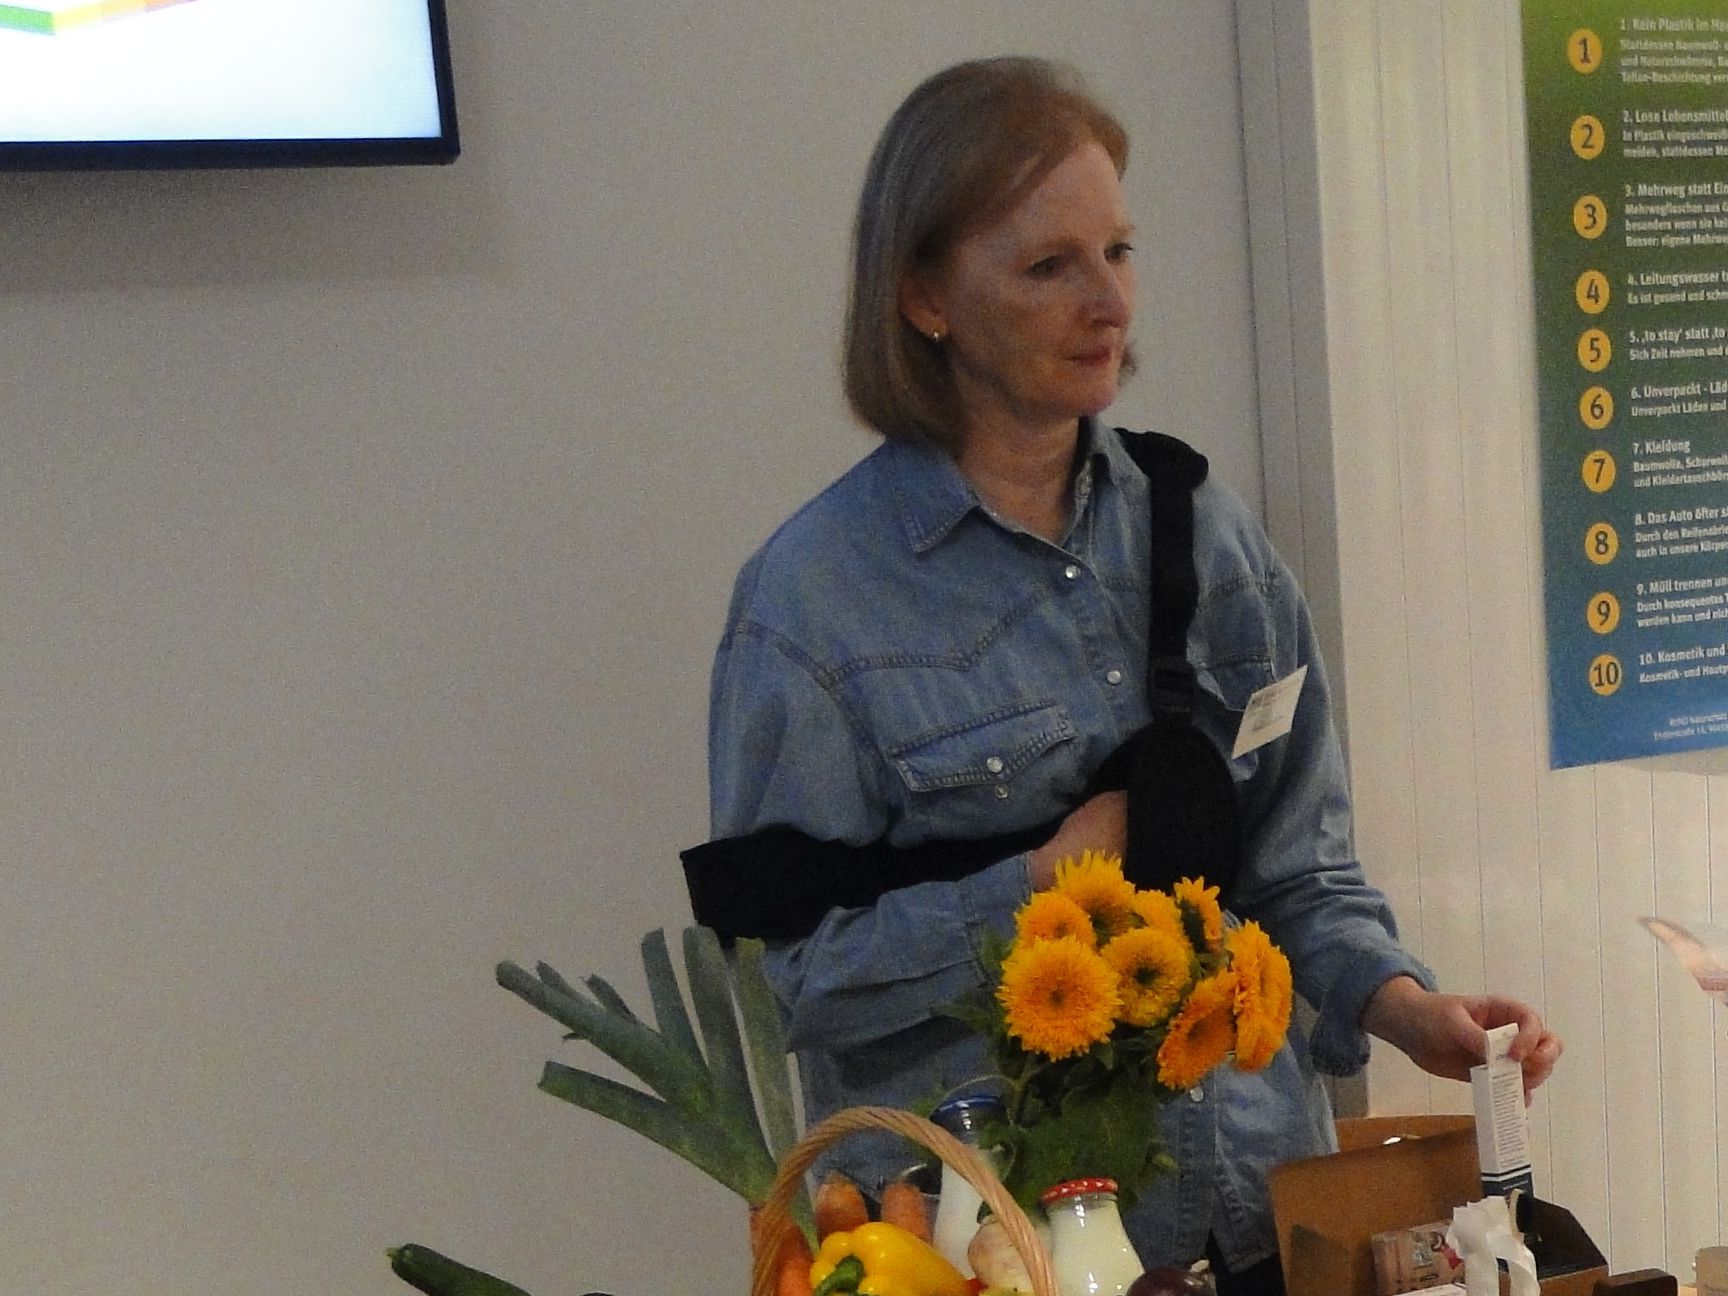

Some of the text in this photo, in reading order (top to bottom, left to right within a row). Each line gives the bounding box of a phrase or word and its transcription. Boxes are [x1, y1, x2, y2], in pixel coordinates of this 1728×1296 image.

[1580, 38, 1591, 64] 1
[1580, 123, 1595, 150] 2
[1583, 204, 1597, 231] 3
[1585, 279, 1601, 304] 4
[1640, 273, 1720, 285] Leitungswasser
[1684, 330, 1710, 340] statt
[1589, 337, 1600, 363] 5
[1631, 388, 1642, 399] 6.
[1644, 384, 1702, 399] Unverpackt
[1589, 394, 1604, 421] 6
[1645, 440, 1691, 455] Kleidung
[1592, 458, 1605, 483] 7
[1647, 513, 1668, 524] Das
[1668, 511, 1694, 522] Auto
[1695, 508, 1719, 520] öfter
[1594, 530, 1608, 556] 8
[1636, 584, 1648, 596] 9.
[1649, 580, 1673, 594] Müll
[1674, 579, 1713, 592] trennen
[1596, 599, 1610, 627] 9
[1639, 653, 1657, 666] 10.
[1658, 646, 1706, 663] Kosmetik
[1706, 644, 1727, 658] und
[1594, 661, 1619, 688] 10
